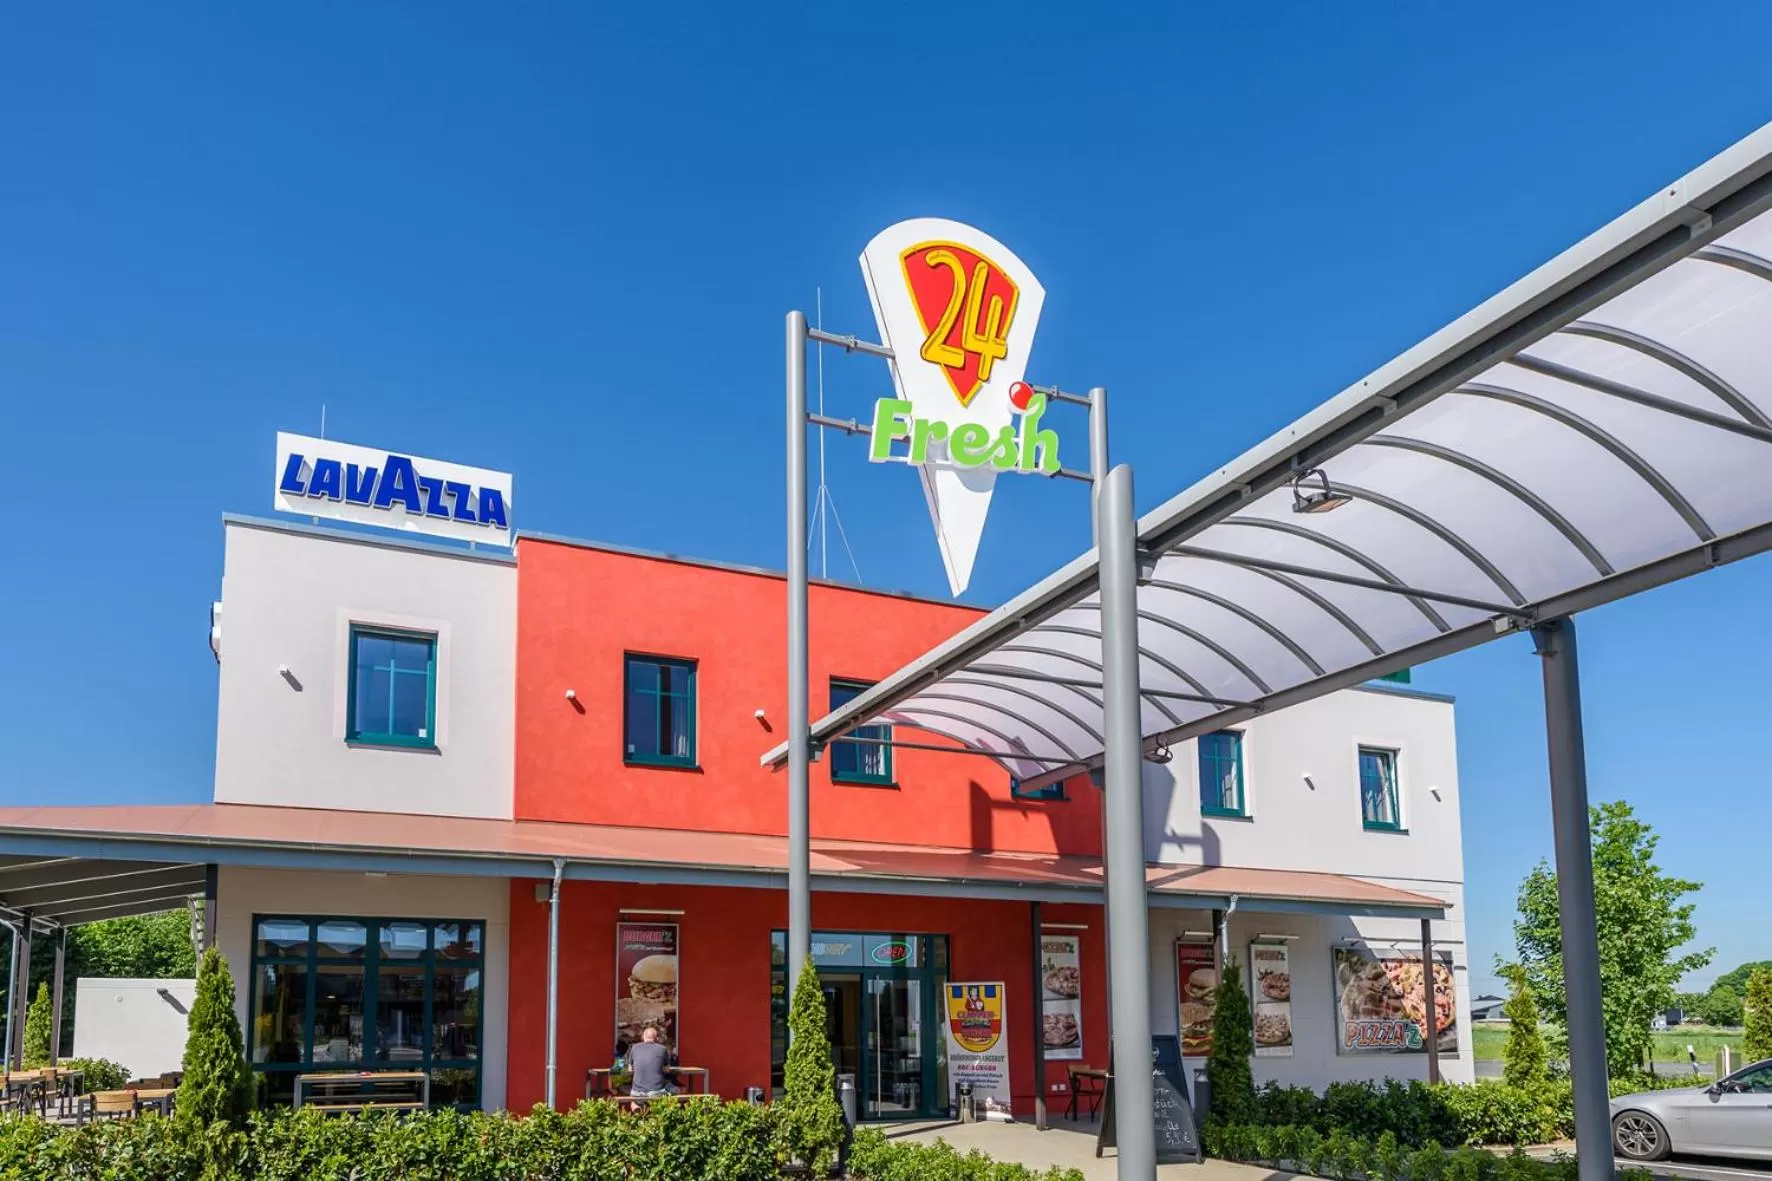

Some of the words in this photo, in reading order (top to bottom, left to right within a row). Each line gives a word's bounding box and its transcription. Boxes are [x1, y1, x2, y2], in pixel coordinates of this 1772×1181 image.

[920, 249, 1009, 382] 24
[869, 392, 1061, 475] Fresh
[876, 946, 908, 959] OPEN
[1344, 1020, 1422, 1049] PIZZA'Z
